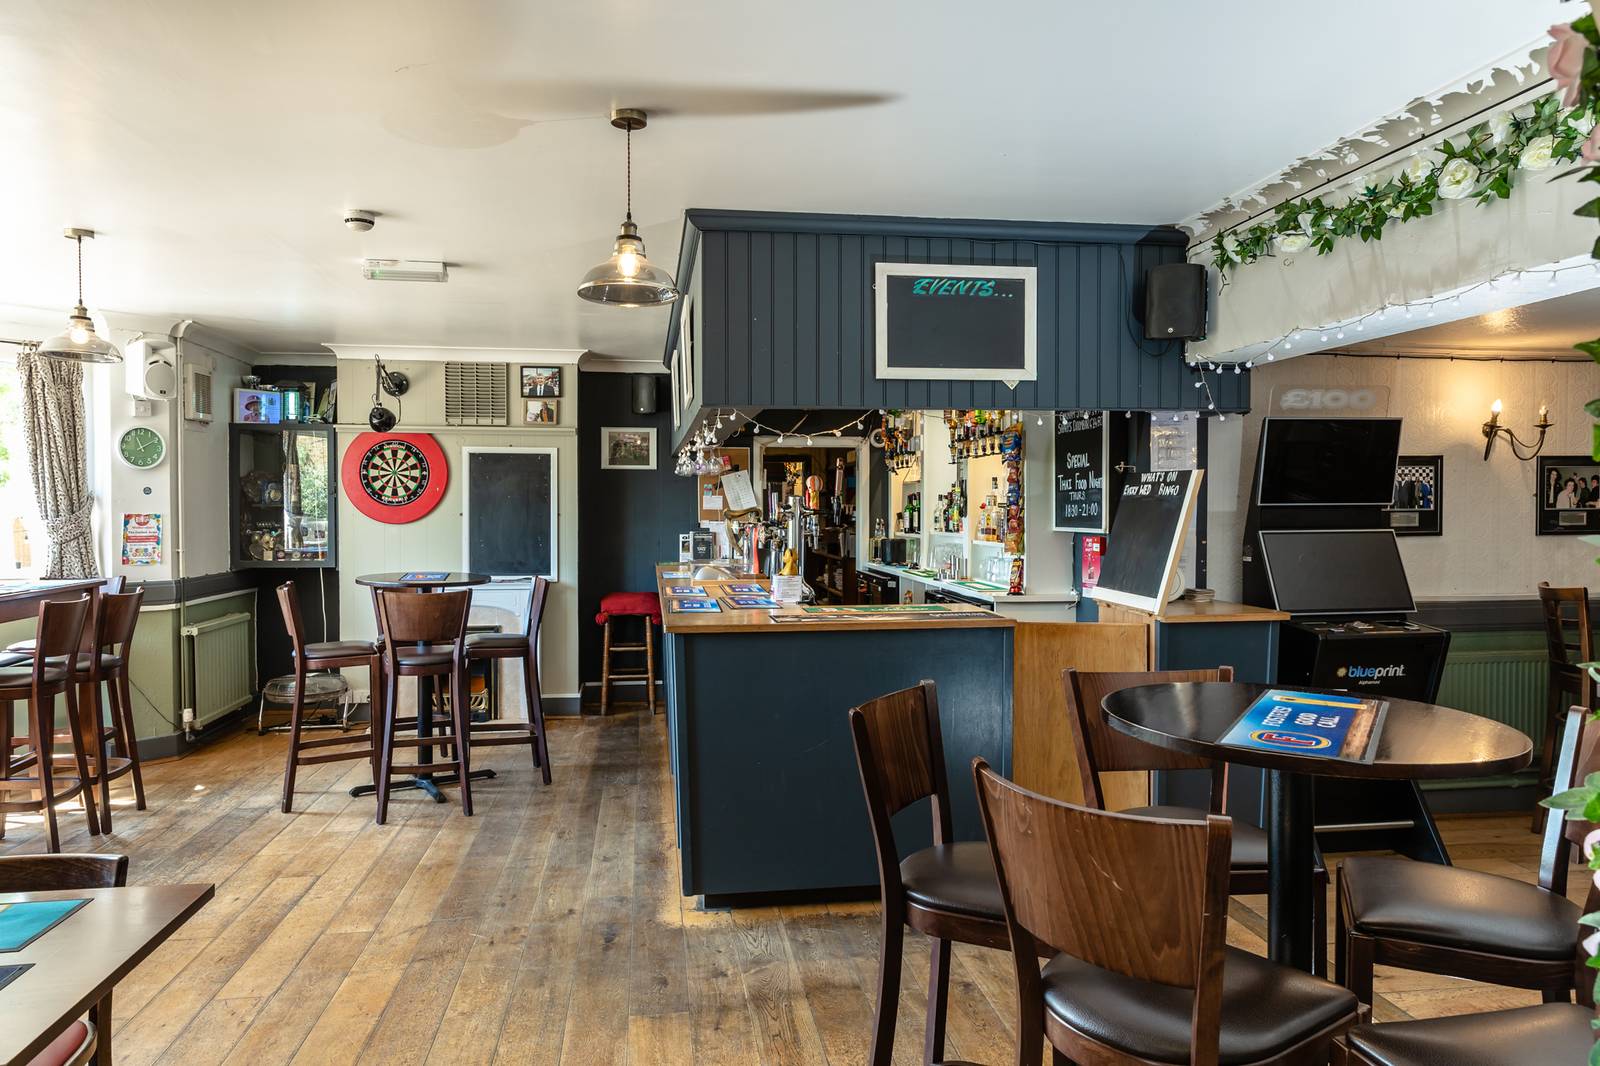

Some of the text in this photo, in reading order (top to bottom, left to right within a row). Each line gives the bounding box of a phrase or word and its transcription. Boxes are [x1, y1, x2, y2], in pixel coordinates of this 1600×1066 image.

[1280, 388, 1376, 410] £100
[1066, 452, 1090, 469] SPECIAL
[1075, 472, 1088, 490] FOOD
[1166, 470, 1178, 482] ON
[1138, 484, 1152, 496] WED
[1158, 482, 1180, 496] BINGO
[1348, 664, 1406, 680] blueprint
[1294, 712, 1318, 726] GOOD
[1316, 715, 1341, 729] CALL
